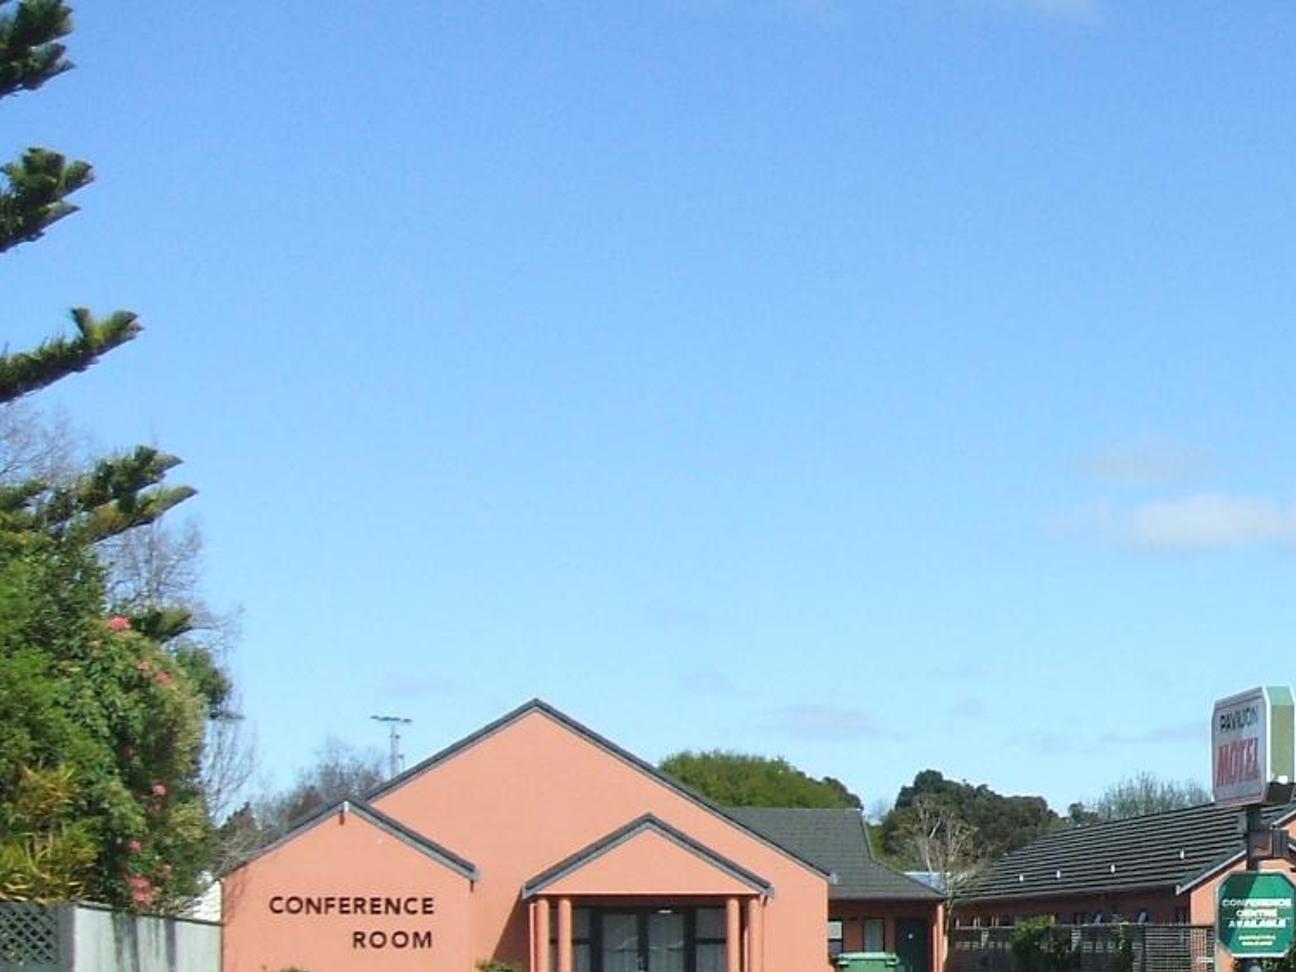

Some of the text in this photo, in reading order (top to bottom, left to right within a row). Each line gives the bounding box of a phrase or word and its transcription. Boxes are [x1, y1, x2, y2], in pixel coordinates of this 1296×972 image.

[1219, 705, 1259, 732] PAVILION
[1216, 736, 1260, 788] MOTEL
[269, 896, 435, 915] CONFERENCE
[352, 930, 433, 949] ROOM
